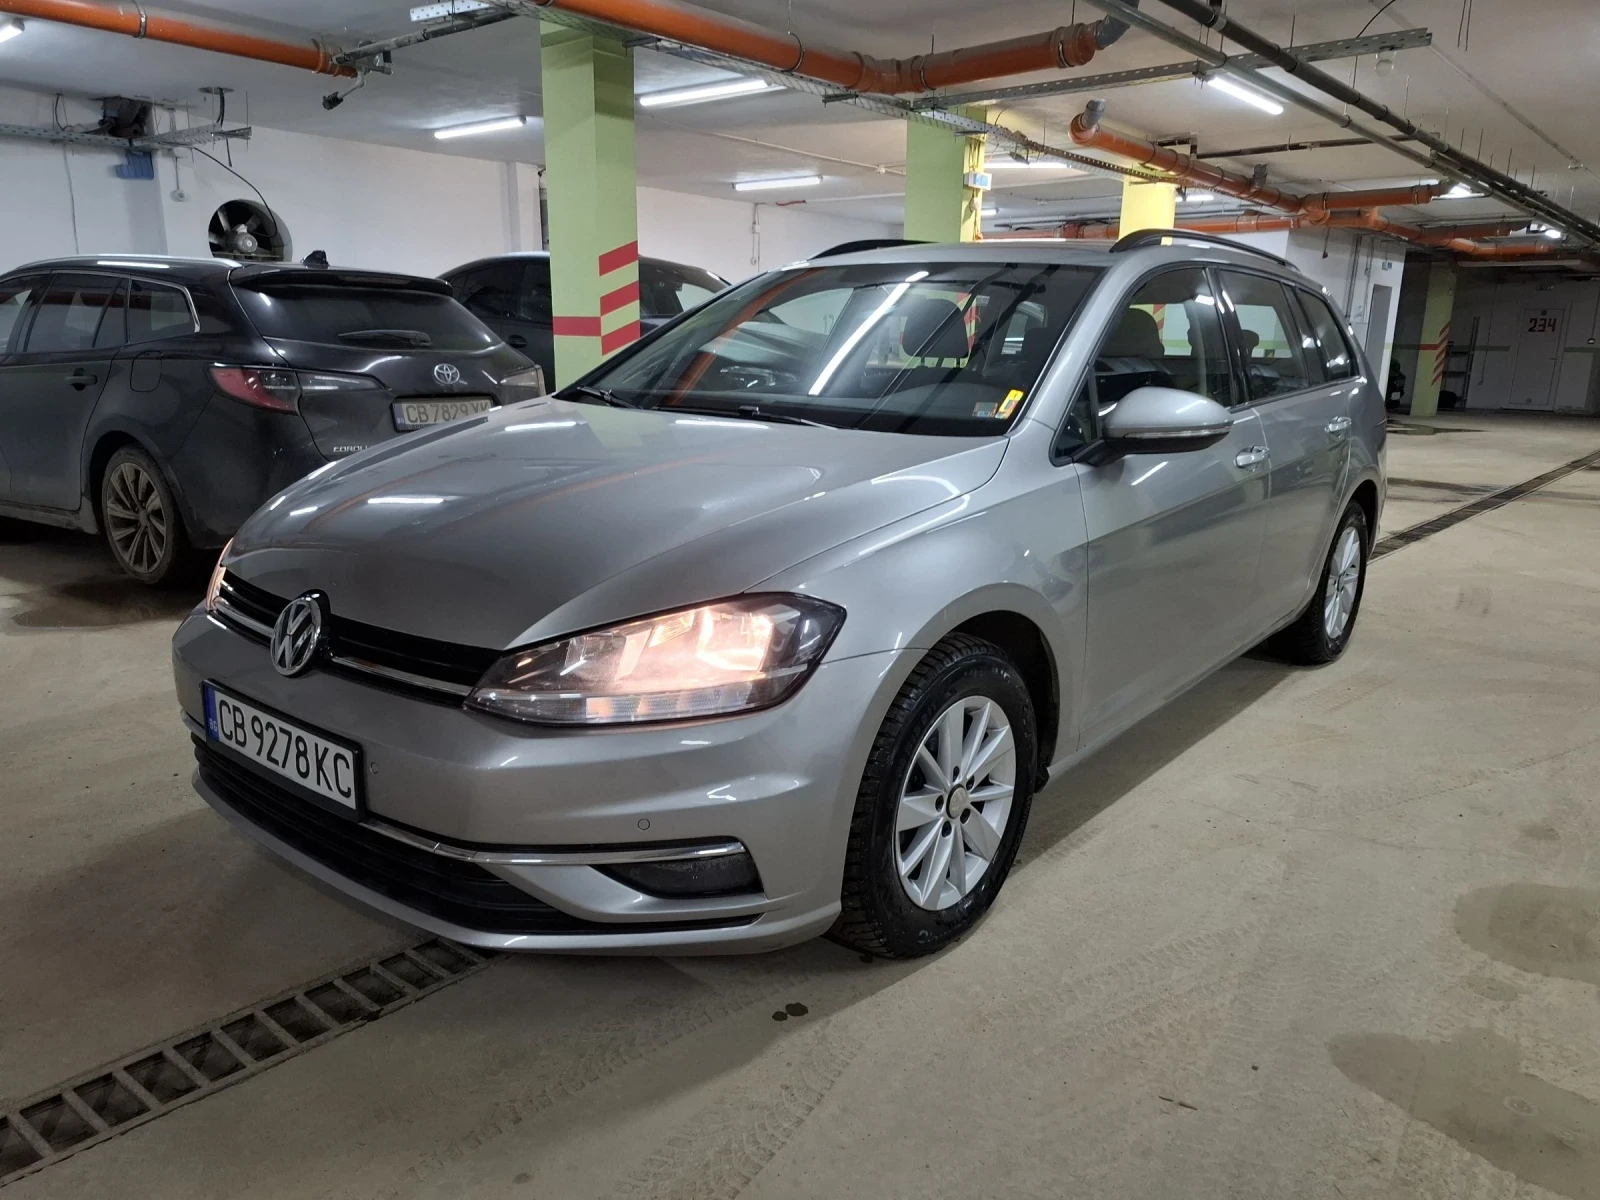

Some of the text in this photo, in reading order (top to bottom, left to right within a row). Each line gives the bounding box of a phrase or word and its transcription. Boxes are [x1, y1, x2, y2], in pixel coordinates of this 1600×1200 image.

[1528, 318, 1557, 332] 234
[406, 404, 429, 423] CB
[219, 699, 352, 799] CB 9278 KC
